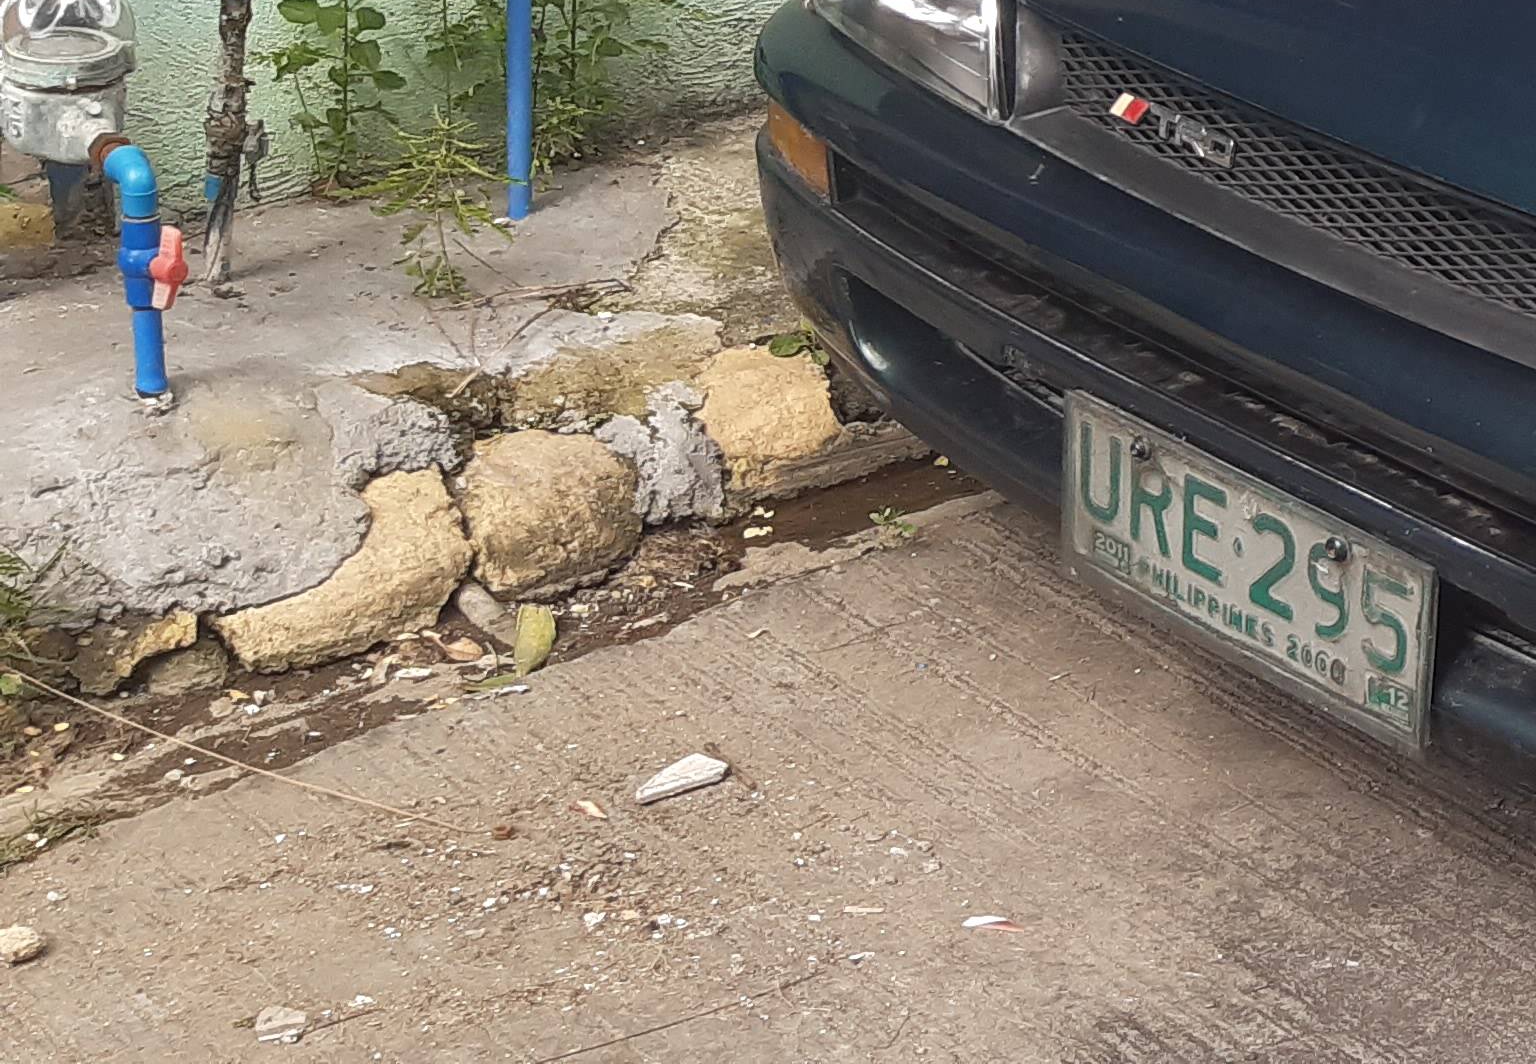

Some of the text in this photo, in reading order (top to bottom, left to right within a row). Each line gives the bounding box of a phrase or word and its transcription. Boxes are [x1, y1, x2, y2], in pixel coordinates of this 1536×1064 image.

[1080, 422, 1415, 673] URE 295
[1093, 532, 1131, 563] 2011
